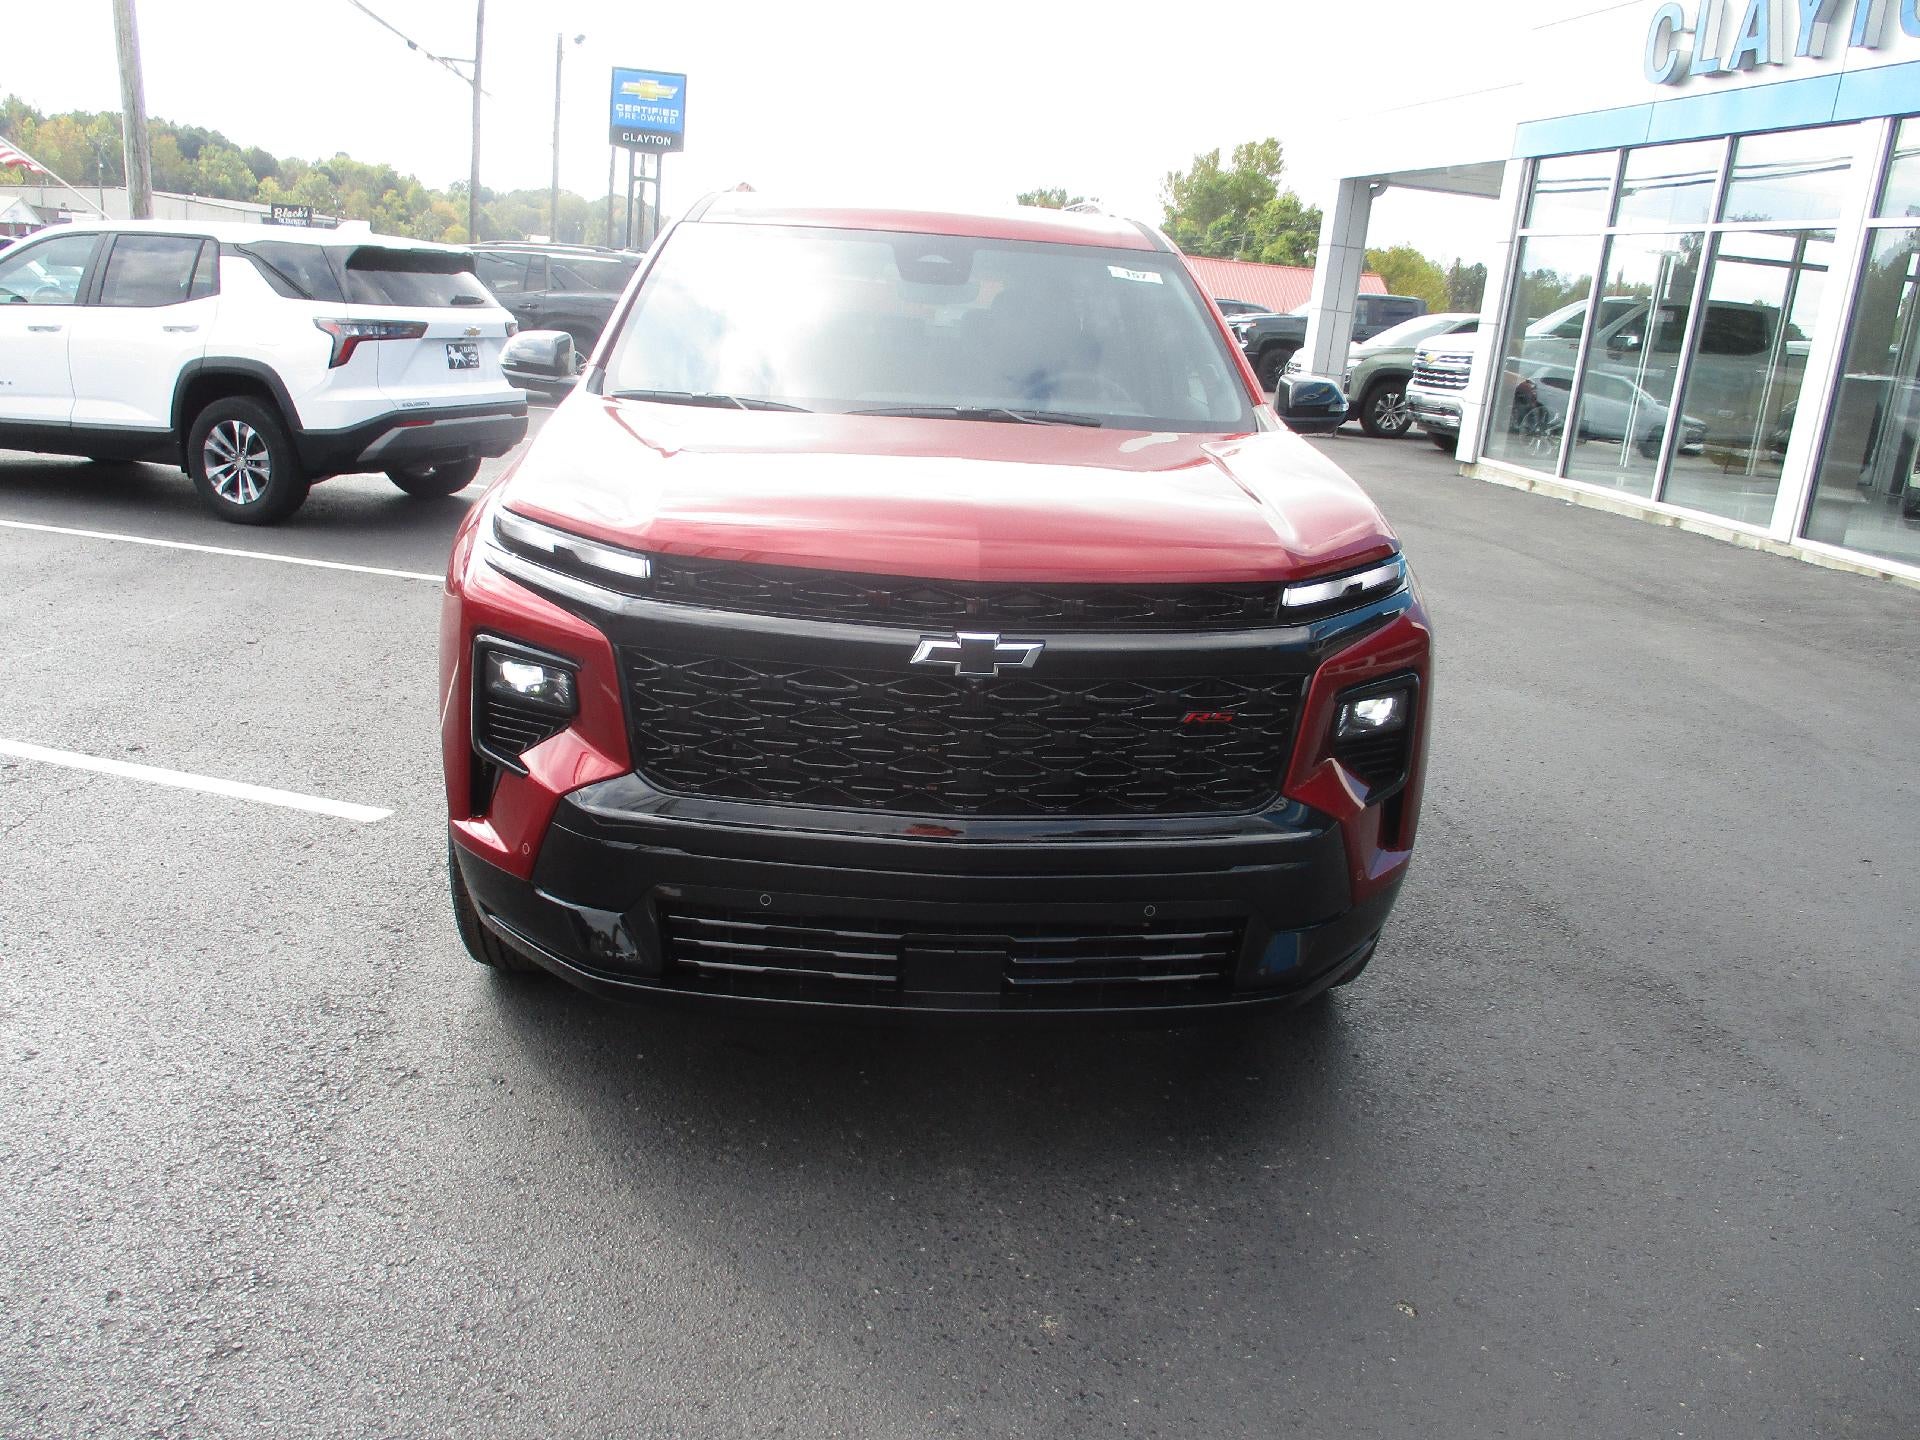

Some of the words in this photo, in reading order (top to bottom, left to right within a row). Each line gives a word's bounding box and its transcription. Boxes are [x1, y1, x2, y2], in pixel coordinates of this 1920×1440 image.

[615, 103, 680, 118] CERTIFIED
[617, 111, 676, 125] PRE-OWNED
[622, 132, 671, 146] CLAYTON
[1181, 711, 1234, 724] RS
